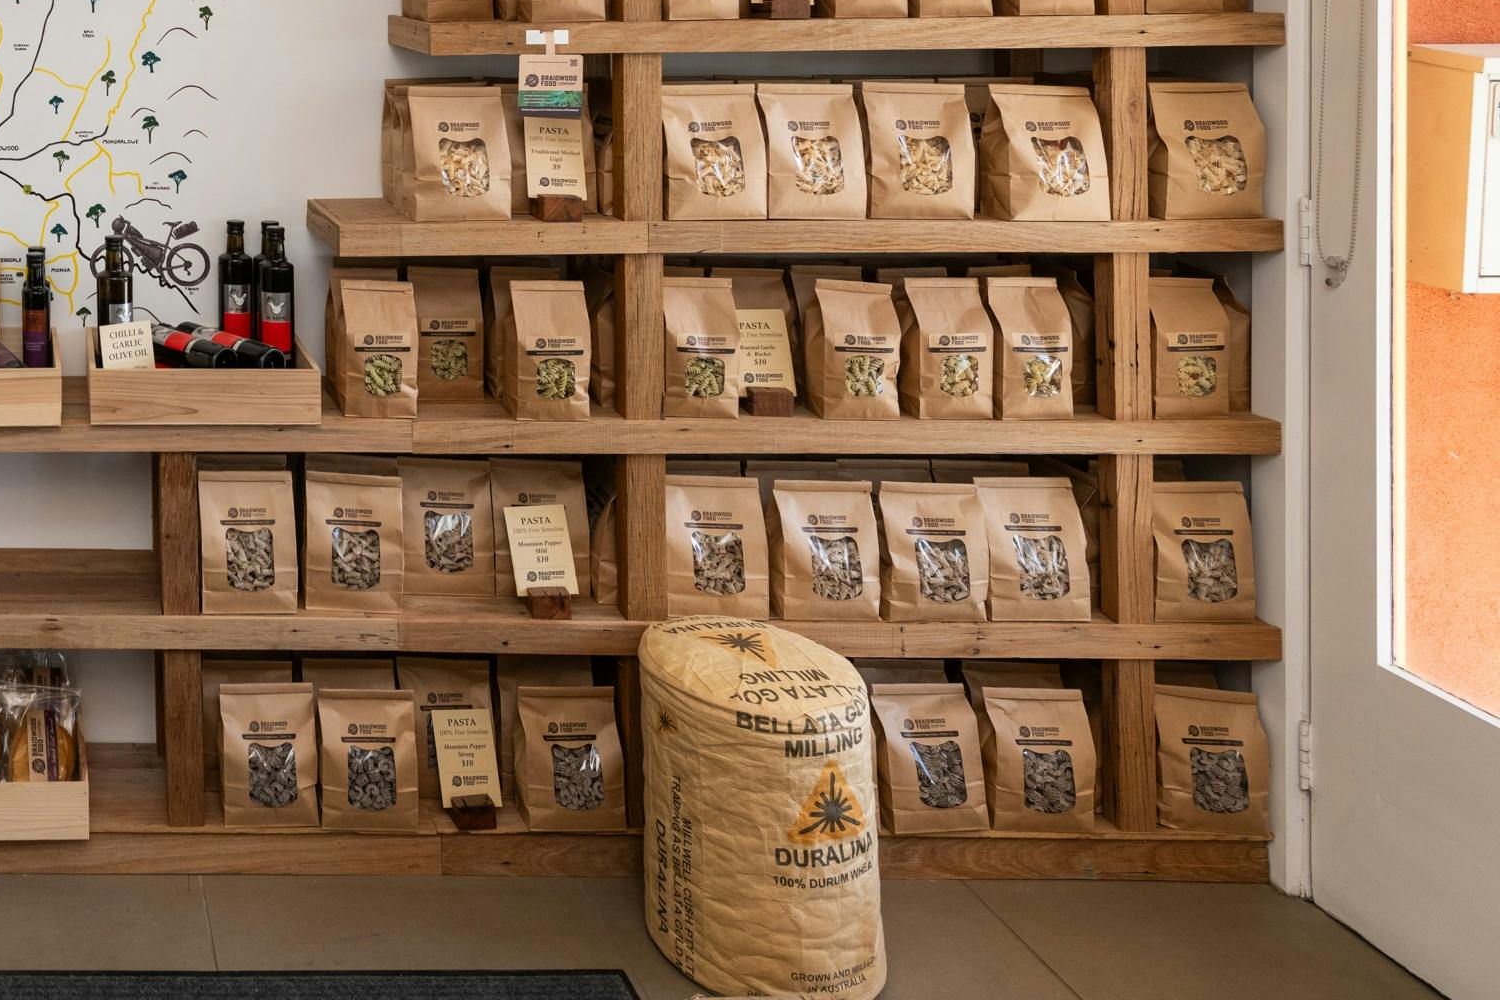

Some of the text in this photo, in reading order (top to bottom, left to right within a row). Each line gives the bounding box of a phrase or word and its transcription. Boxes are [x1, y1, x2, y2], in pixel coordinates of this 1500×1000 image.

[539, 127, 569, 135] PASTA
[109, 330, 136, 340] CHILLI
[112, 339, 143, 349] GARLIC
[108, 349, 148, 361] OLIVE OIL
[521, 517, 551, 525] PASTA
[447, 718, 477, 726] PASTA
[736, 710, 844, 735] BELLATA
[785, 727, 863, 758] MILLING
[462, 759, 474, 767] $10
[671, 775, 682, 832] TRADING
[672, 836, 681, 853] AS
[775, 833, 873, 868] DURALINA
[656, 818, 669, 933] DURALINA
[773, 873, 849, 889] 100% DURUM
[672, 855, 683, 914] BELLATA
[683, 887, 693, 924] CUSH
[790, 972, 831, 982] GROWN
[833, 968, 850, 981] AND
[808, 973, 867, 993] IN AUSTRALIA
